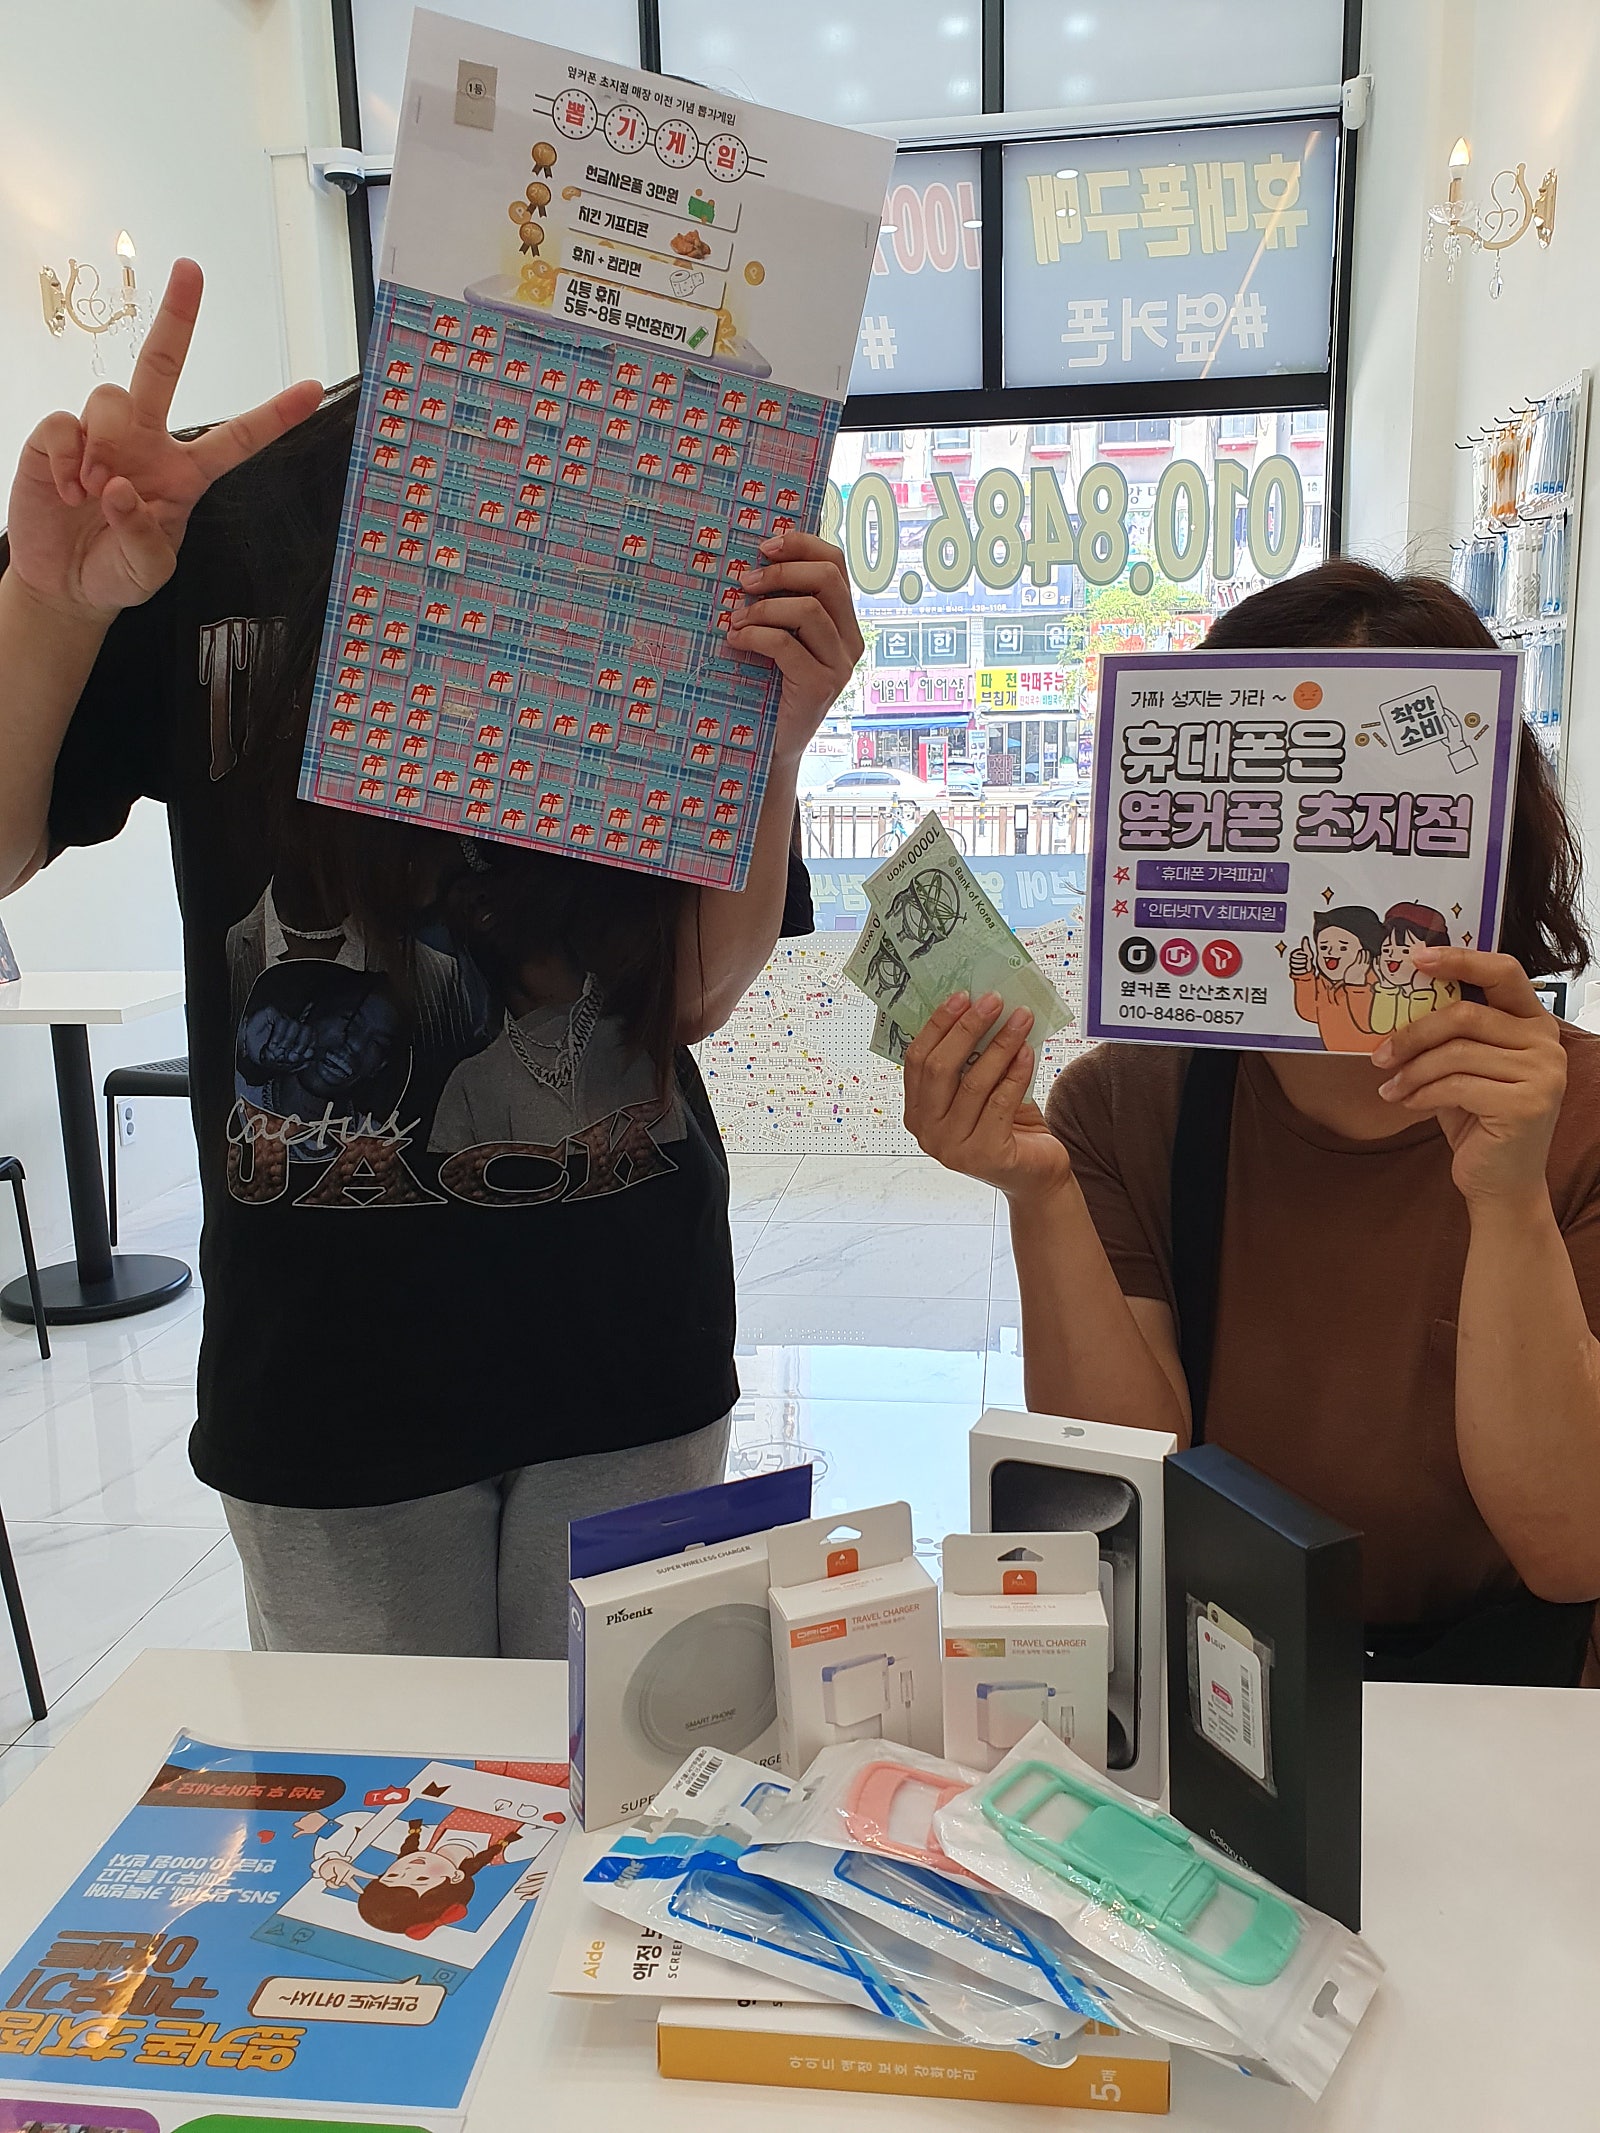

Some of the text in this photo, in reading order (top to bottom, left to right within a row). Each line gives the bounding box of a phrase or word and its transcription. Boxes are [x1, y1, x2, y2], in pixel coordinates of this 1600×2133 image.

[468, 82, 484, 97] 1등
[567, 65, 597, 85] 옆커폰
[599, 74, 629, 95] 초지점
[631, 85, 651, 102] 매장
[654, 91, 674, 109] 이전
[676, 97, 695, 115] 기념
[585, 164, 679, 205] 현금사은품 3만원
[578, 205, 649, 239] 치킨 기프티콘
[572, 246, 595, 266] 휴지
[607, 255, 642, 278] 컵라면
[567, 279, 621, 307] 4등 휴지
[564, 296, 687, 343] 5등~8등 무선충전기
[1130, 691, 1164, 709] 가짜
[1171, 690, 1223, 708] 성지는
[1229, 689, 1265, 707] 가라
[1391, 696, 1437, 724] 착한
[1400, 715, 1444, 747] 소비
[1120, 720, 1346, 784] 휴대폰은
[1119, 789, 1474, 858] 옆커폰 초지점
[887, 826, 940, 882] 10000 won
[954, 866, 971, 892] Bank
[968, 889, 978, 901] of
[976, 901, 996, 929] Korea
[1120, 981, 1267, 1004] 옆커폰 안산초지점
[1119, 1004, 1244, 1024] 010-8486-0857
[656, 1545, 752, 1575] SUPER WIRELESS CHARGER
[606, 1606, 653, 1626] Phoenix
[852, 1612, 881, 1625] TRAVEL
[883, 1603, 920, 1618] CHARGER
[1012, 1639, 1087, 1648] TRAVEL CHARGER
[685, 1708, 736, 1730] SMART PHONE
[176, 1782, 325, 1800] 작성 후 보여주세요
[107, 1853, 151, 1868] 받자
[96, 1867, 158, 1885] 올리고
[83, 1882, 165, 1900] 카톡방에
[38, 1931, 199, 1973] 이벤트
[583, 1940, 606, 1980] Aide
[633, 1945, 663, 1980] 액정
[668, 1940, 683, 1979] SCREE
[347, 1994, 420, 2012] 인터넷도
[0, 2010, 308, 2071] 옆커폰 초지점
[789, 2055, 978, 2081] 아이드 액정 보호 강화유리
